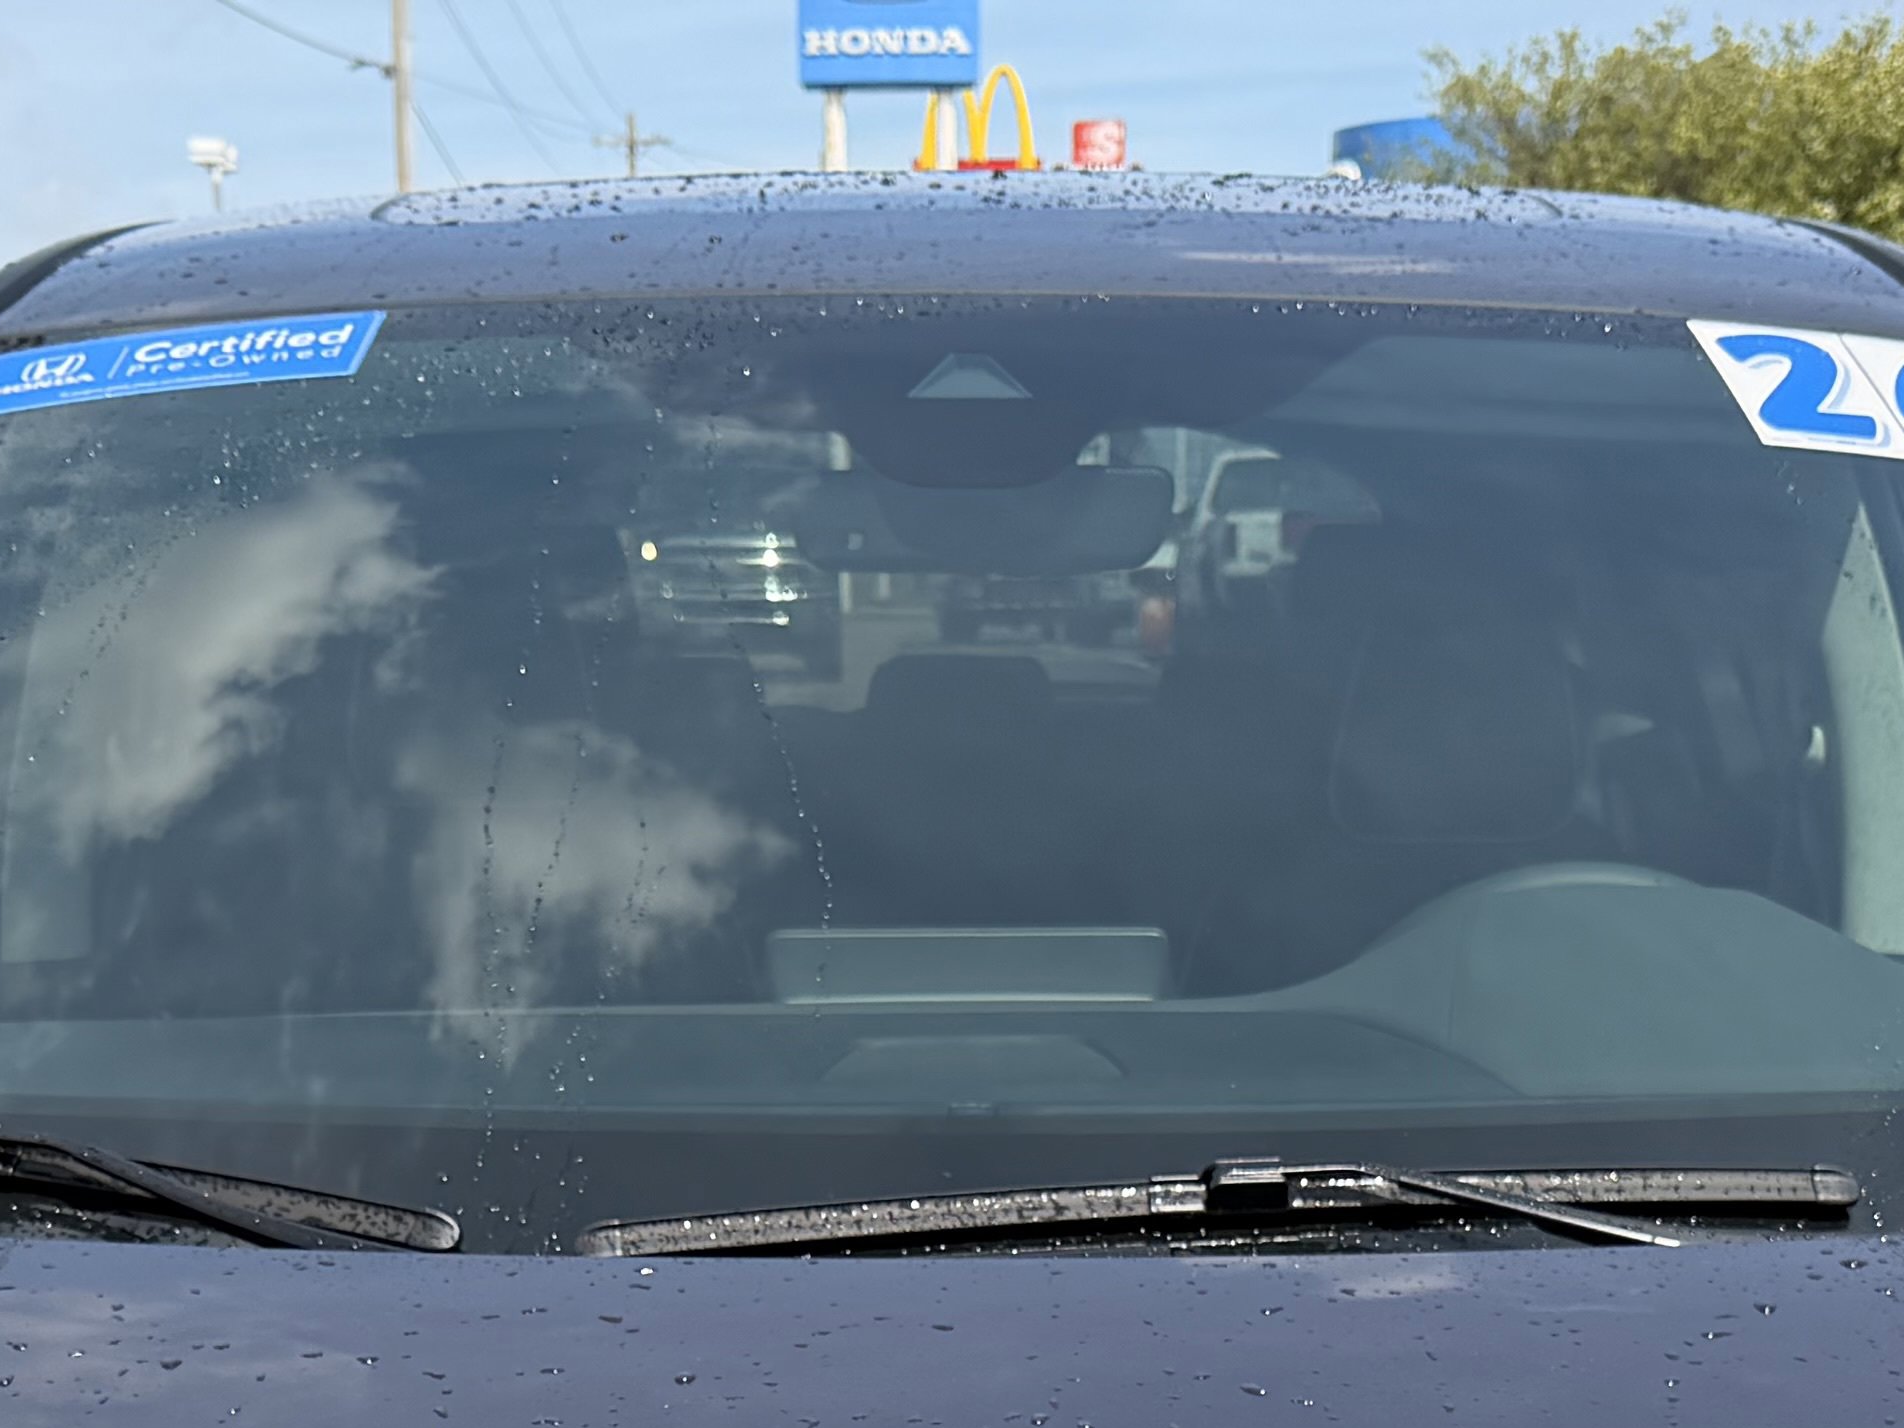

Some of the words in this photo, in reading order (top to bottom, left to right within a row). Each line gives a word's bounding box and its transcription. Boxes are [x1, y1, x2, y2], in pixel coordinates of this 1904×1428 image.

[804, 27, 972, 56] HONDA
[133, 323, 354, 363] Certified
[126, 345, 343, 377] Pre-Owned
